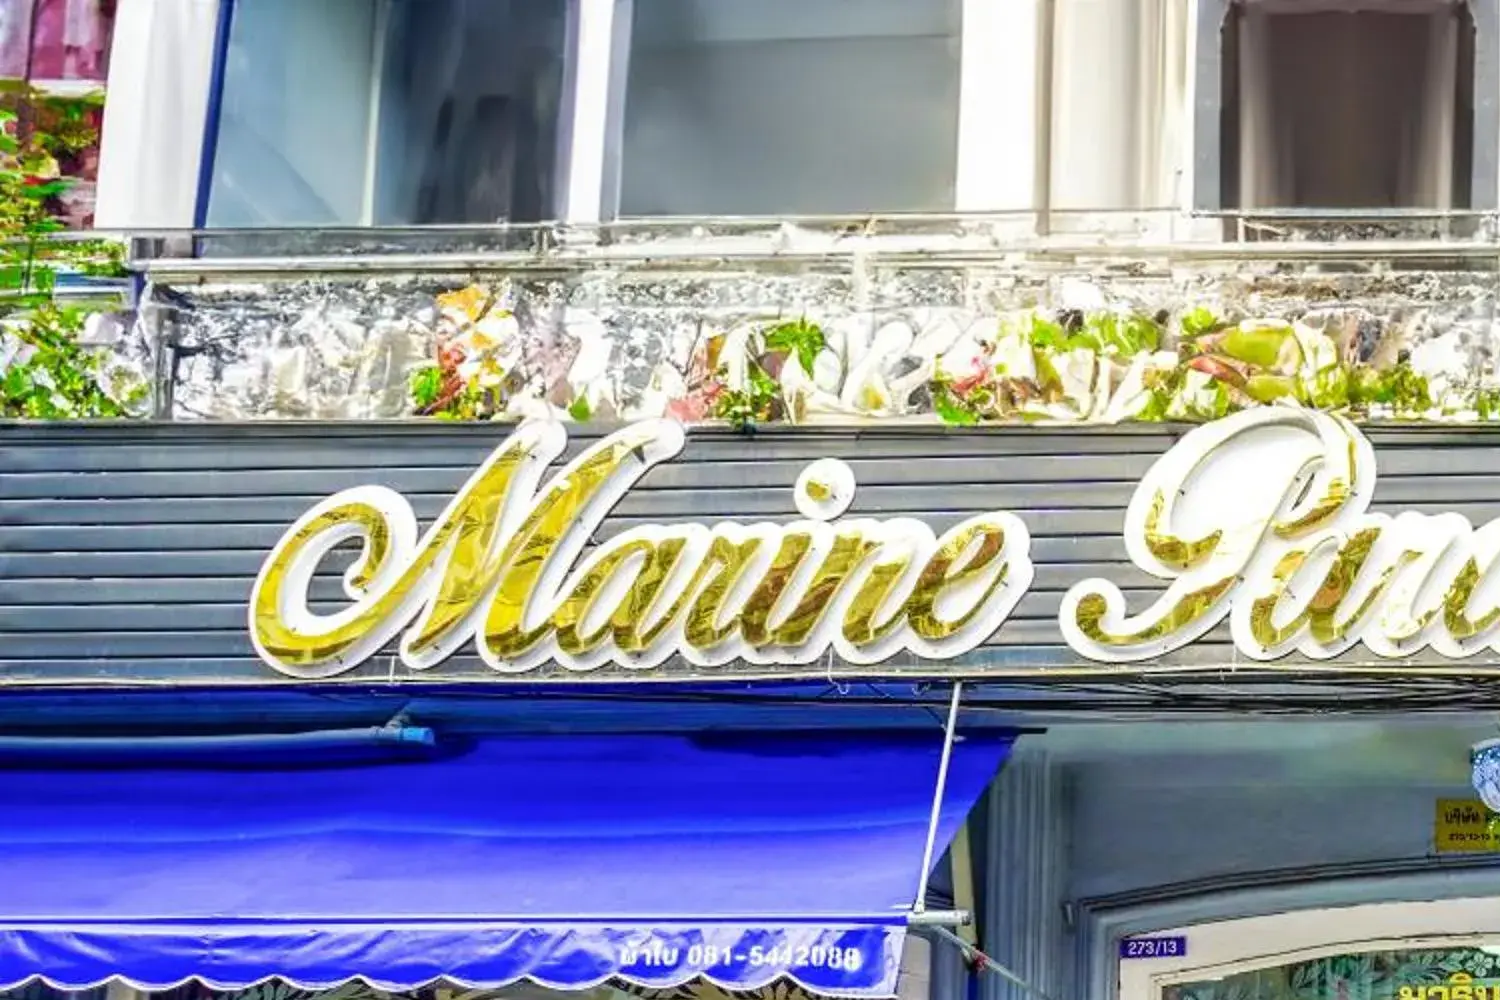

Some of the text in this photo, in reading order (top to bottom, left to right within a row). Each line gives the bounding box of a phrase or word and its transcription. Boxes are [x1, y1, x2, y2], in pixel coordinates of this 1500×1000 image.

[250, 418, 1034, 678] Marine
[619, 939, 862, 972] ผ้าใบ 081-5442088
[1127, 941, 1177, 955] 273/13
